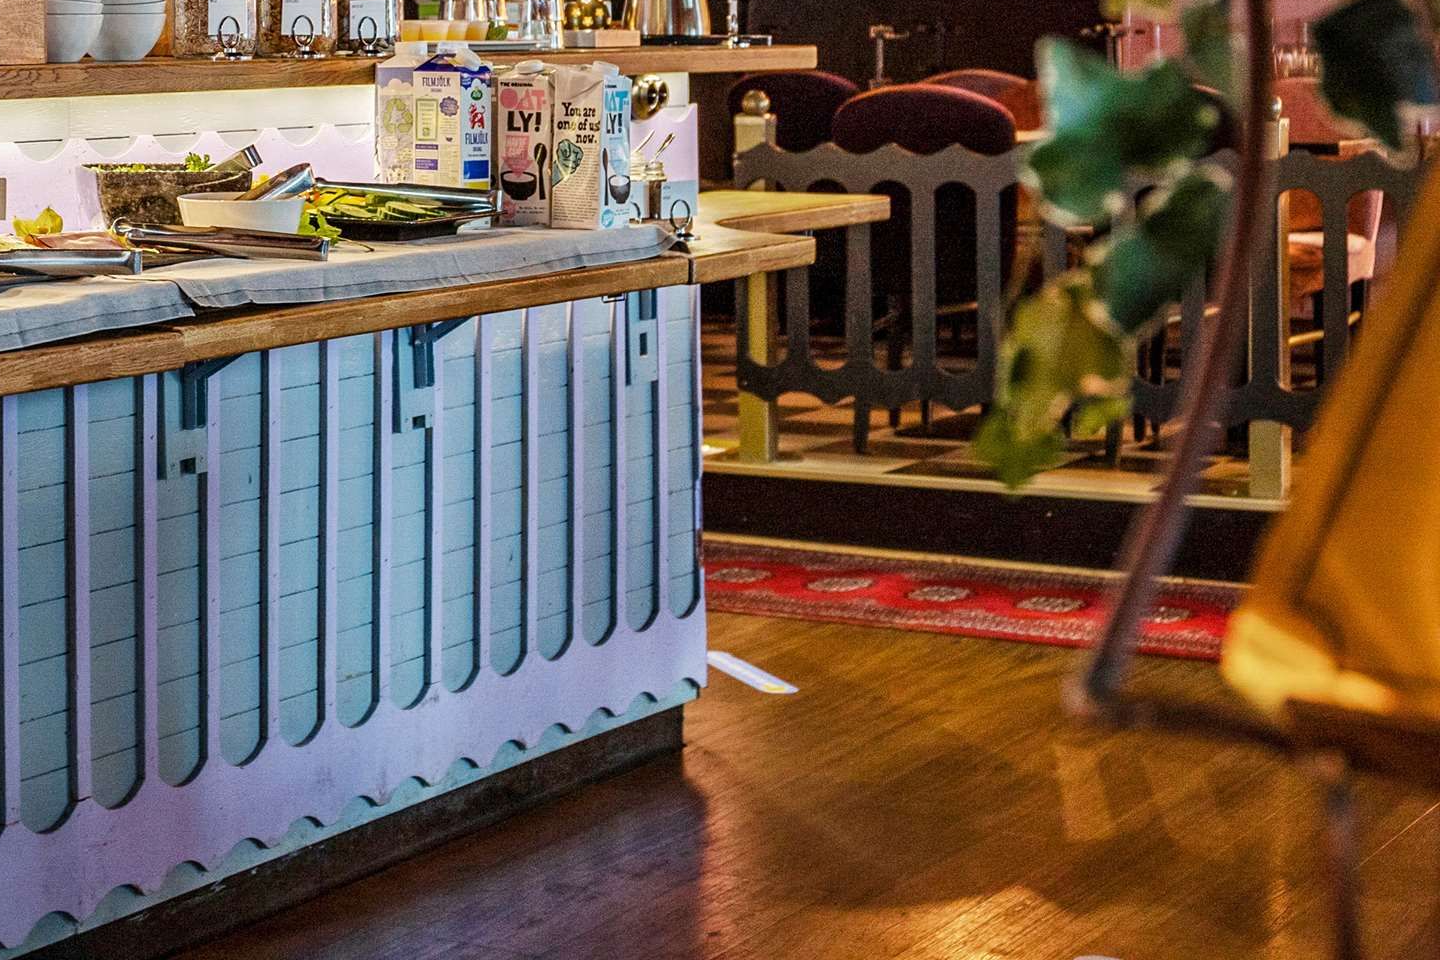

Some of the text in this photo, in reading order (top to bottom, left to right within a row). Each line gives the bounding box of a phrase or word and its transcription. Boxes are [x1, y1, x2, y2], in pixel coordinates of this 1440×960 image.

[422, 75, 451, 87] FILMJÖLK
[561, 102, 596, 118] You are
[507, 110, 542, 132] LY!
[557, 119, 601, 132] one of us
[575, 134, 597, 144] now.
